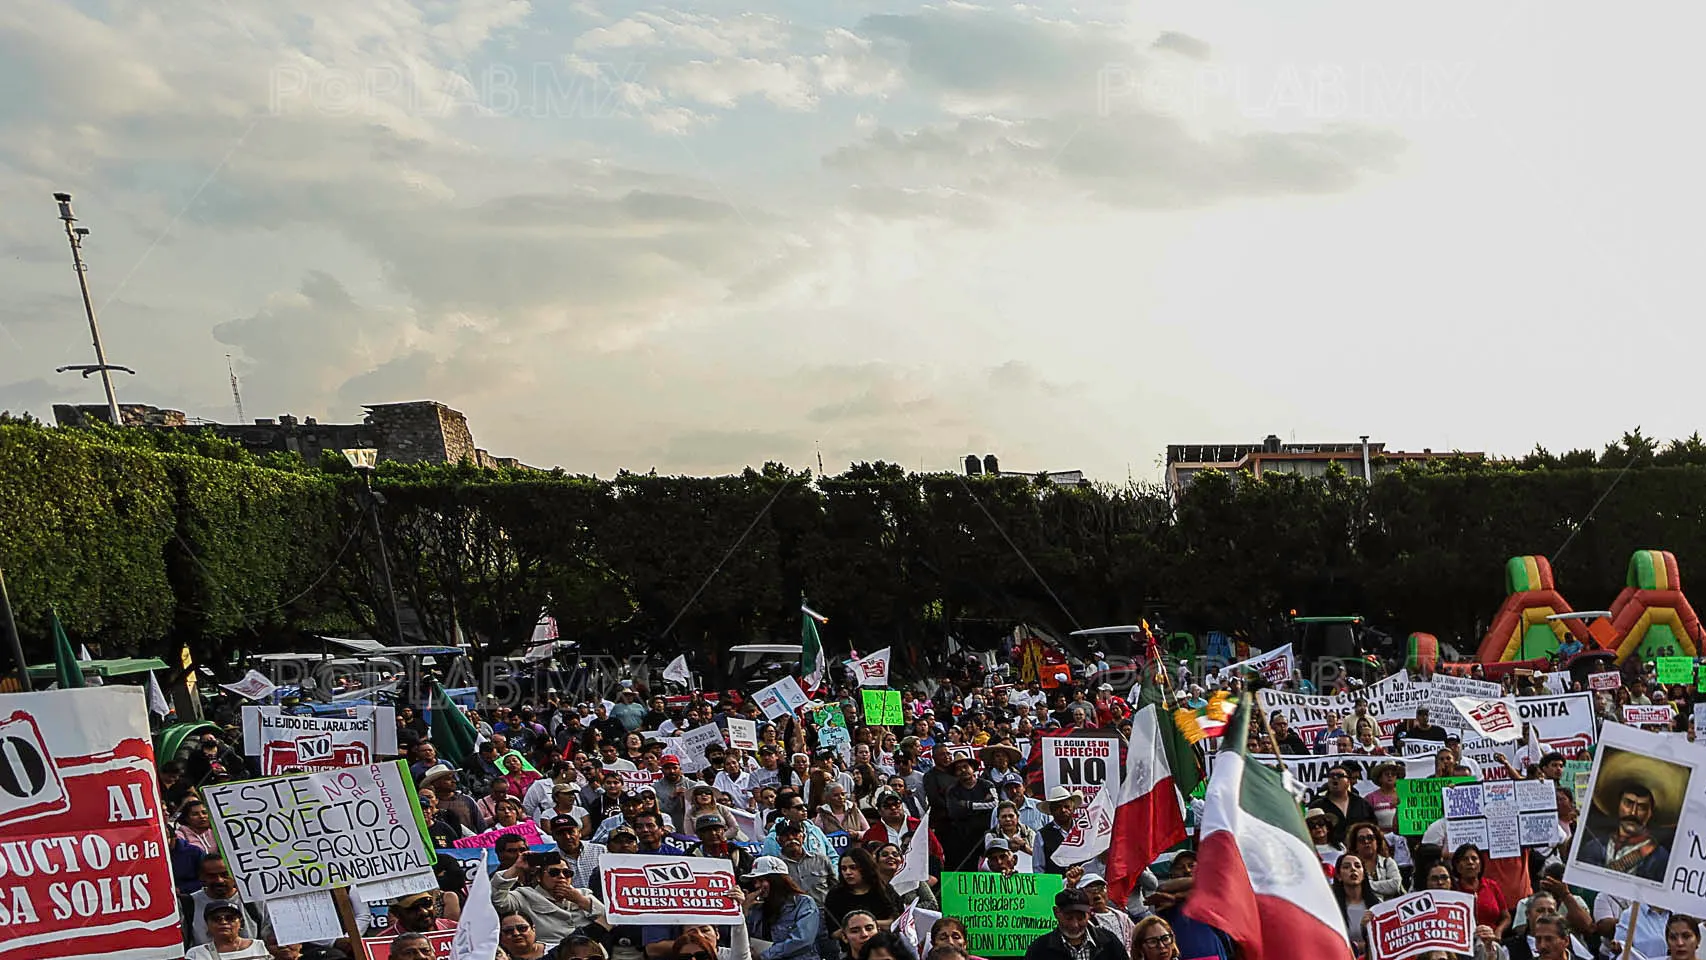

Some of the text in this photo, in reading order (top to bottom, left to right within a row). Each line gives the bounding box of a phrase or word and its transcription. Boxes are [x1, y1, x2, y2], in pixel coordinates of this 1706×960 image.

[1265, 691, 1331, 707] UNIDOS
[1385, 689, 1429, 704] ACUEDUCTO
[275, 718, 301, 730] EJIDO
[303, 720, 320, 731] DEL
[299, 739, 330, 760] NO
[345, 753, 361, 765] AL
[1055, 747, 1109, 757] DERECHO
[1407, 744, 1420, 755] NO
[1059, 757, 1106, 786] NO
[322, 772, 356, 801] NO
[352, 786, 371, 800] AL
[108, 783, 152, 823] AL
[212, 777, 319, 819] ÉSTE
[224, 800, 380, 850] PROYECTO
[115, 840, 160, 861] de la
[236, 825, 410, 873] ES SAQUEO
[236, 873, 252, 896] Y
[260, 864, 323, 895] DAÑO
[329, 849, 431, 883] AMBIENTAL
[650, 866, 691, 885] NO
[621, 886, 706, 898] ACUEDUCTO
[709, 880, 726, 889] AL
[958, 874, 969, 895] EL
[973, 874, 997, 895] AGUA
[1015, 875, 1038, 896] DEBE
[48, 872, 151, 921] SOLIS
[628, 896, 724, 909] PRESA SOLIS
[1402, 895, 1433, 919] NO
[1448, 911, 1463, 920] AL
[1383, 919, 1448, 943] ACUEDUCTO
[1389, 929, 1460, 952] PRESA SOLIS
